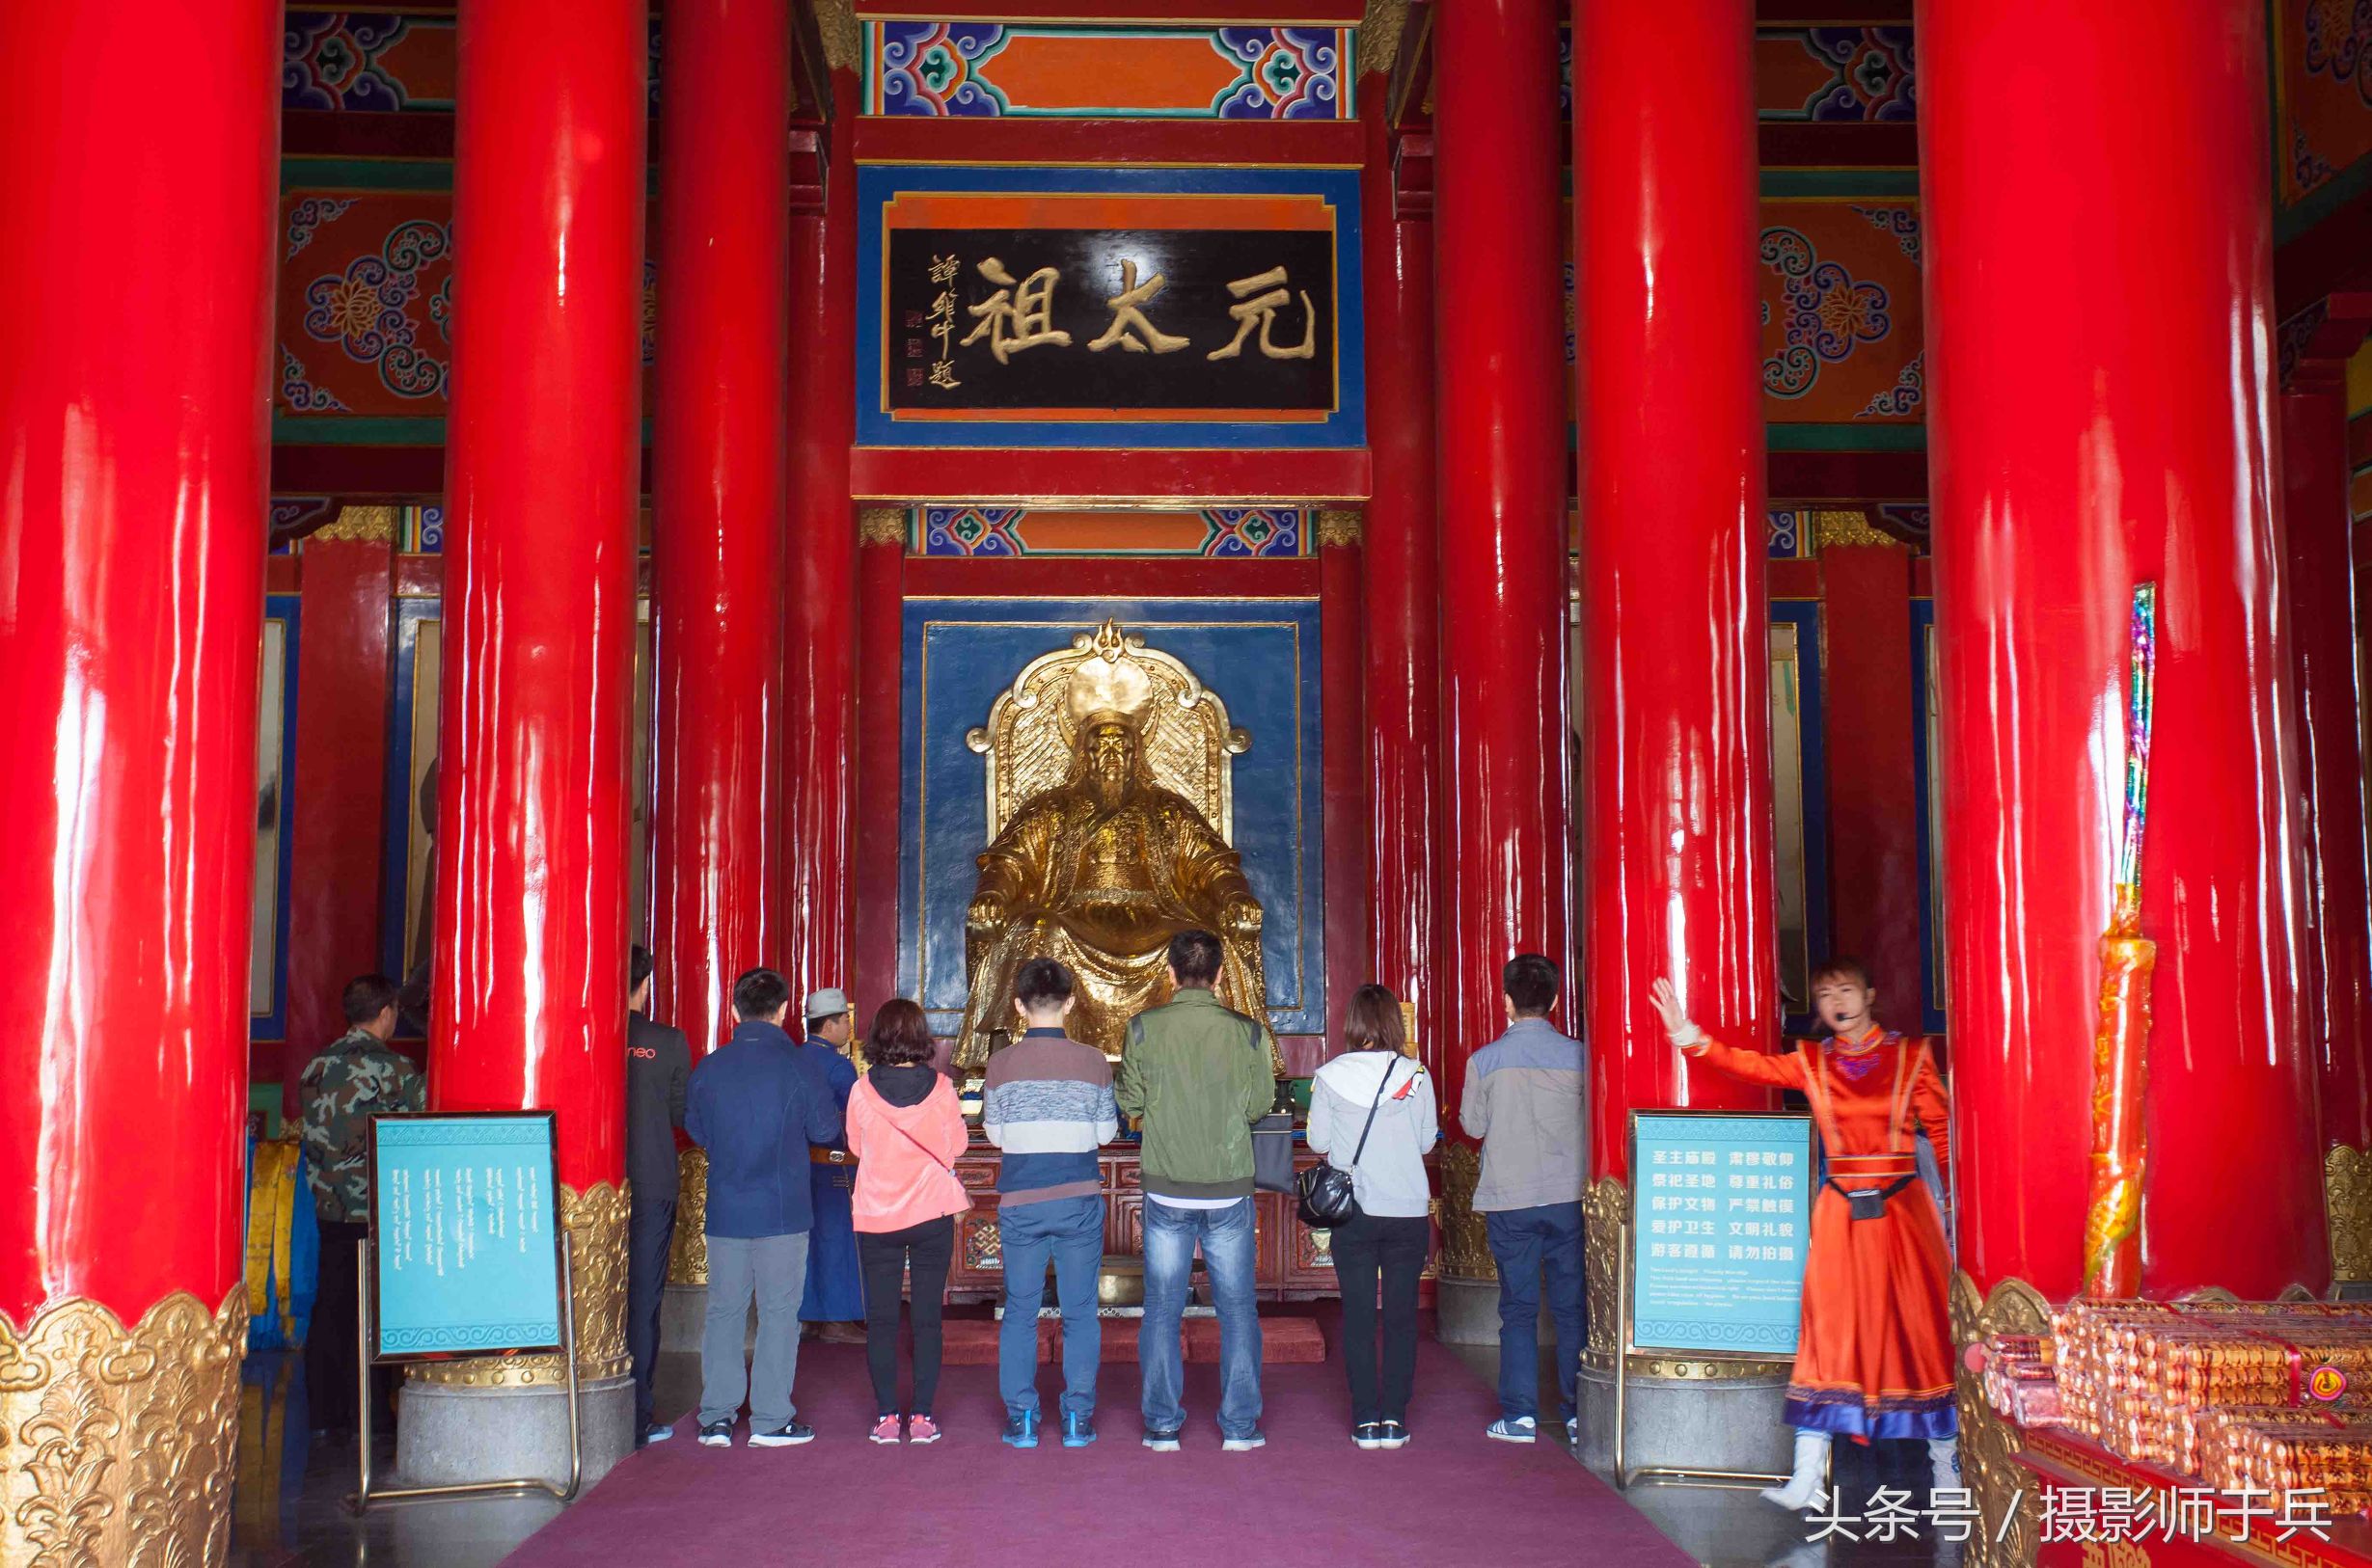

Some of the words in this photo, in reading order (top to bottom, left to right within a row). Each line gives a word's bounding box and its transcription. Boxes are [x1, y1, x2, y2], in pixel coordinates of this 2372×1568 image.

[1728, 1175, 1794, 1190] 尊重礼俗
[1650, 1196, 1716, 1211] 保护文物
[1650, 1219, 1716, 1234] 爱护卫生
[1728, 1221, 1794, 1237] 文明礼貌
